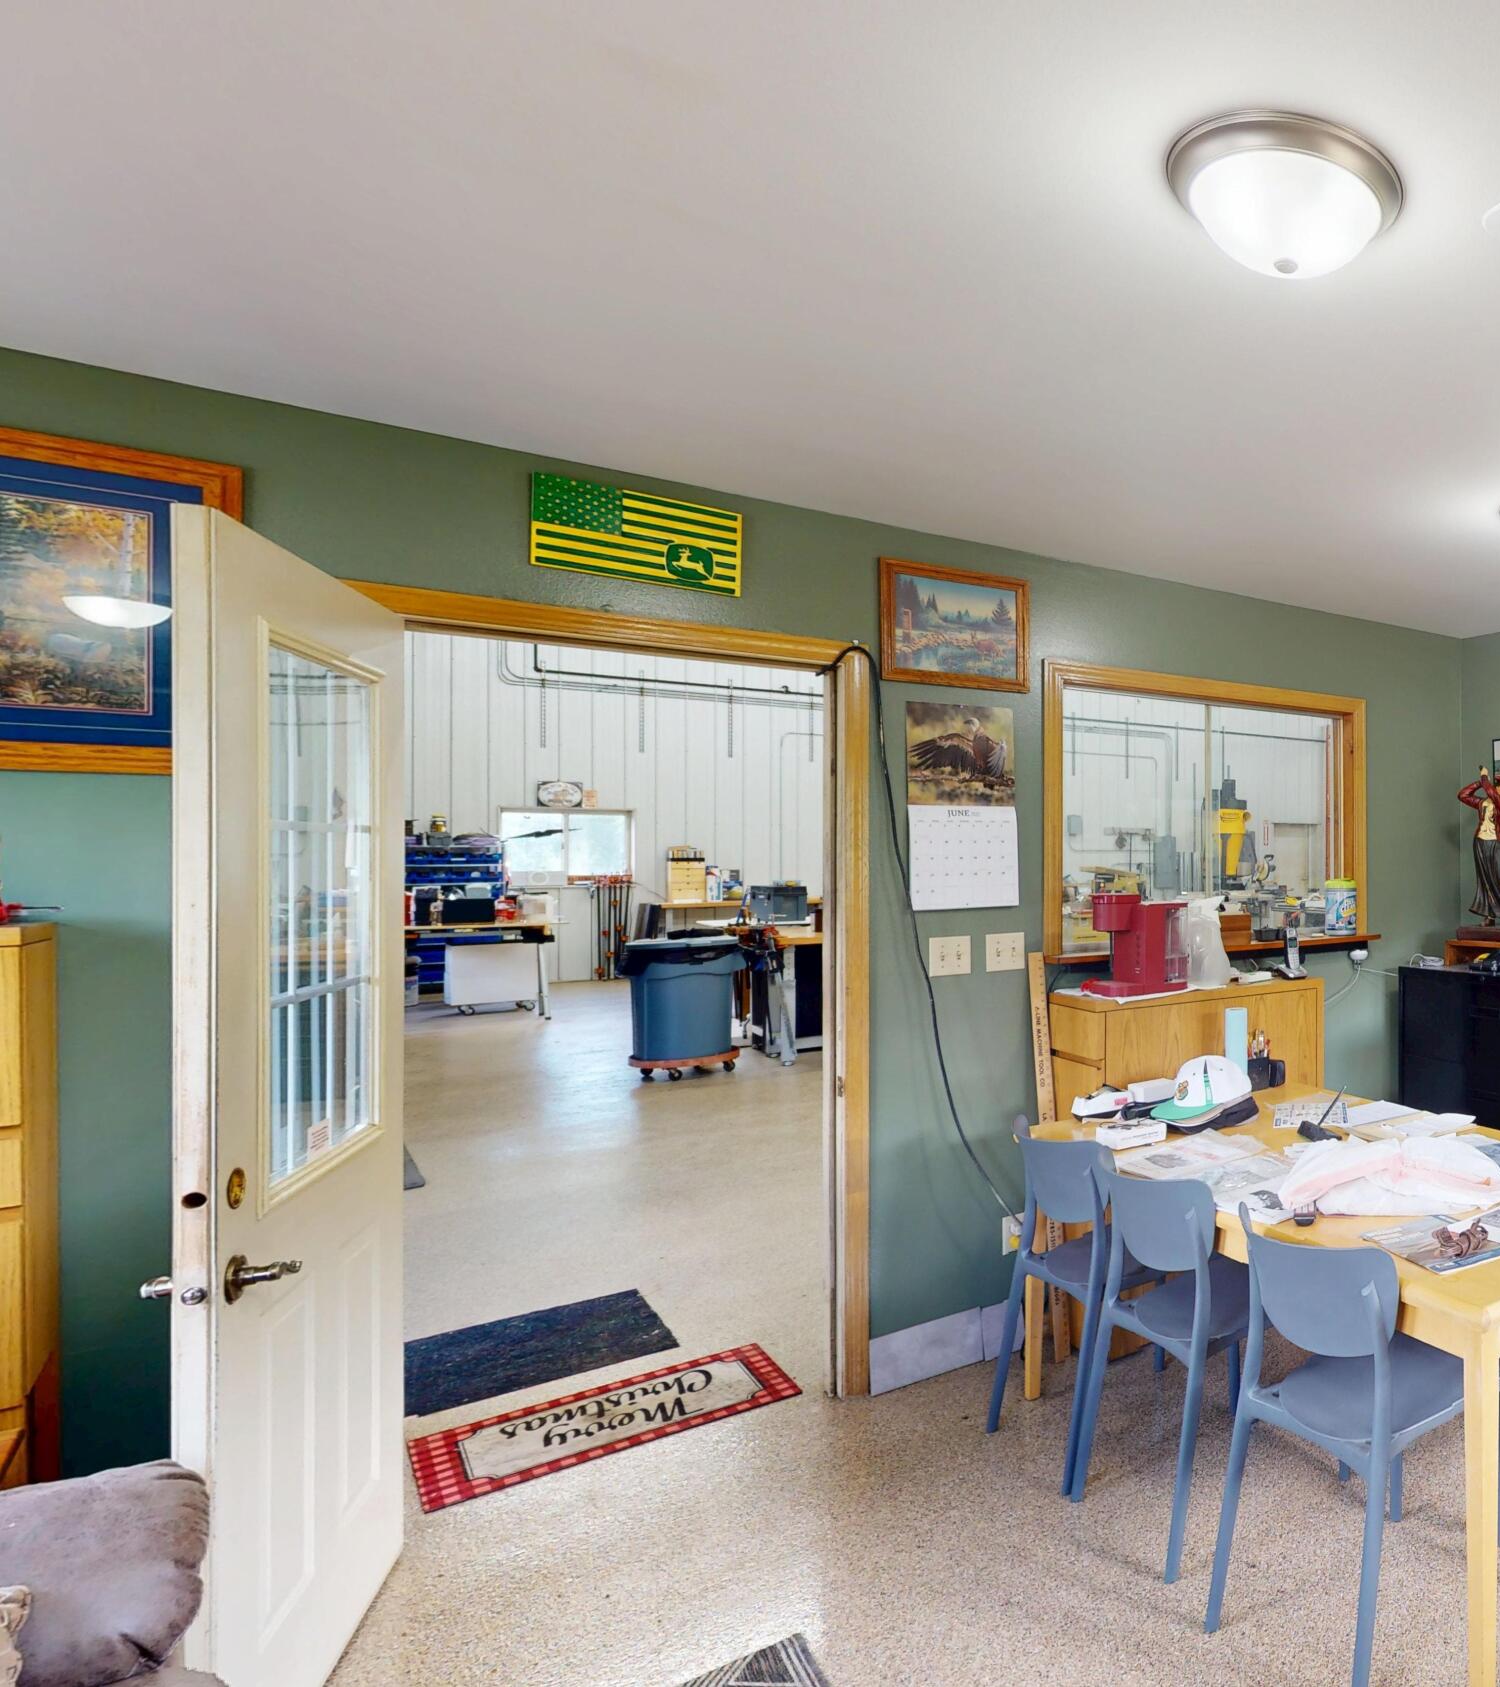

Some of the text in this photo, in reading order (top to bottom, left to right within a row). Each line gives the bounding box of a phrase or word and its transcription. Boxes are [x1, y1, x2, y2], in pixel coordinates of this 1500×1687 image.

[947, 809, 970, 818] JUNE
[499, 1369, 712, 1440] Christmas
[542, 1397, 704, 1448] Merry
